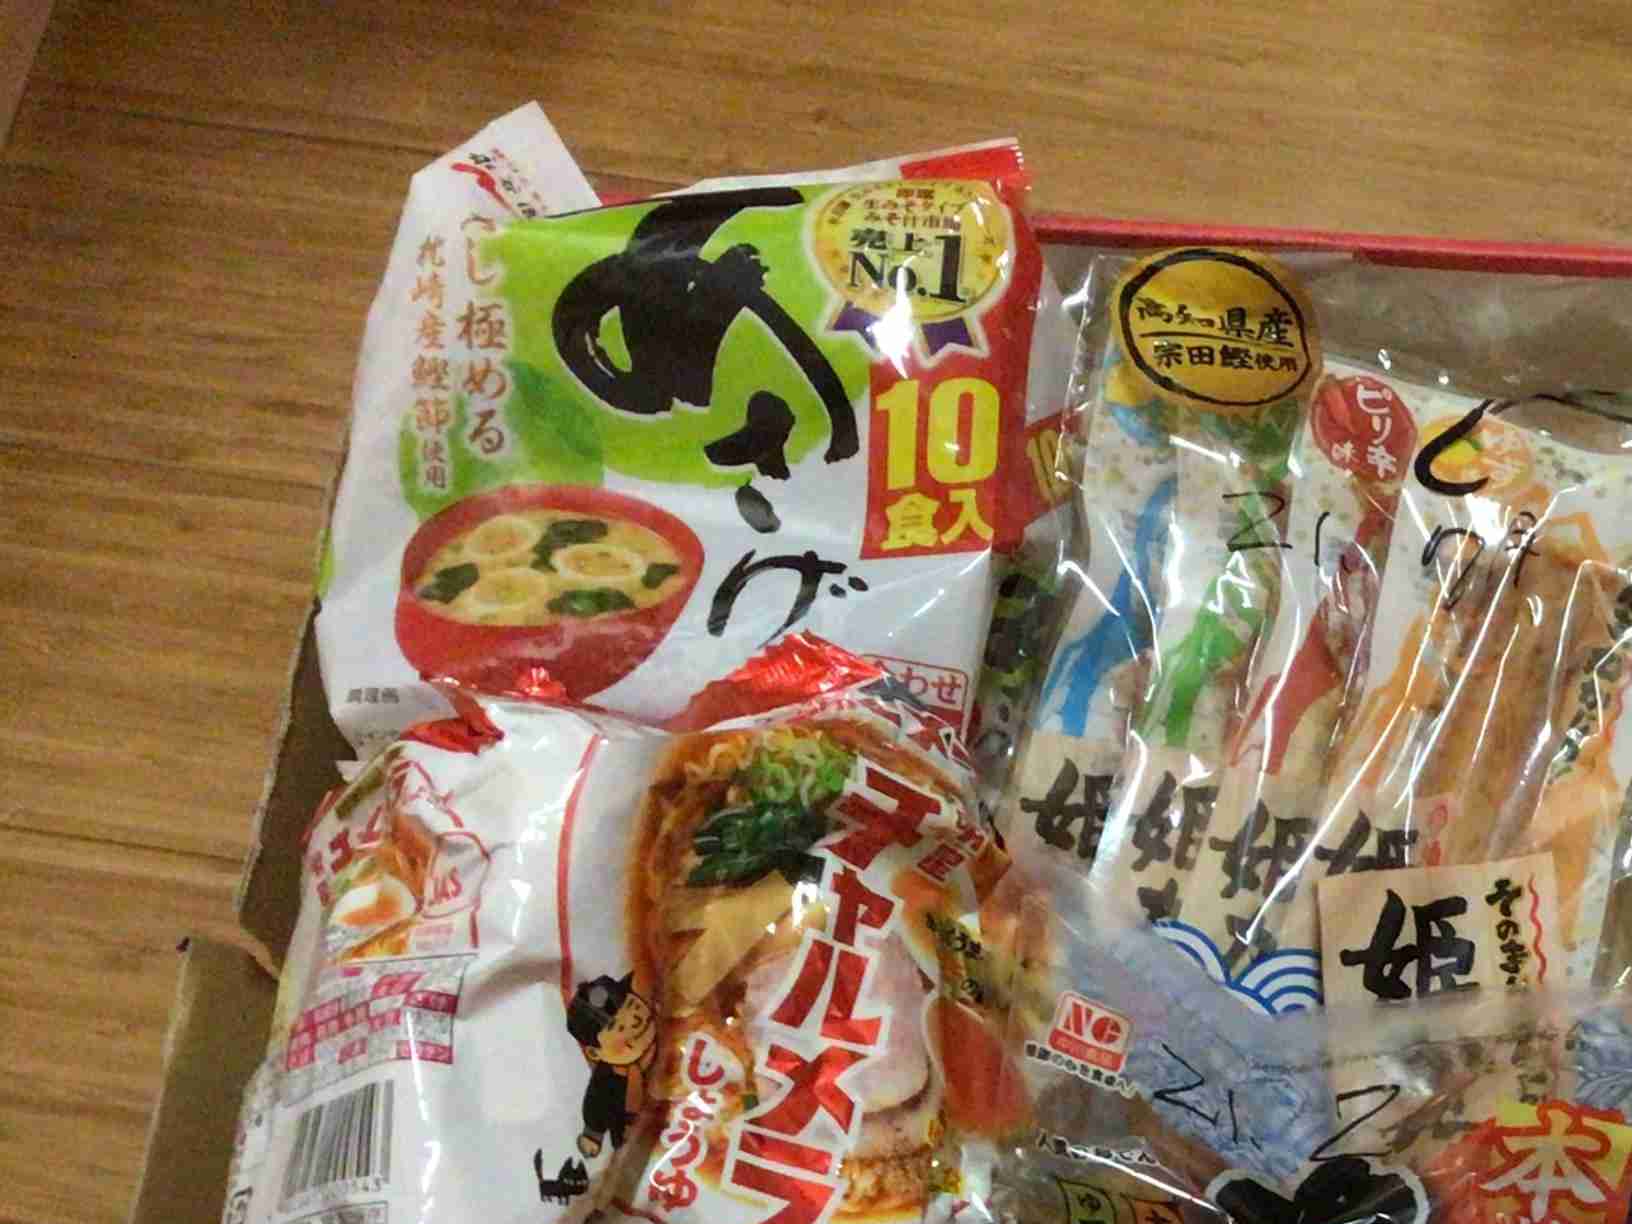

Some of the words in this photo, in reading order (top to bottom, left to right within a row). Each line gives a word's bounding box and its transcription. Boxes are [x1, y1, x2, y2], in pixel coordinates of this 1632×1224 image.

[848, 234, 968, 303] No.1
[850, 228, 930, 252] 売上
[1136, 299, 1294, 348] 高知県産
[1151, 341, 1298, 375] 宗田鰹使用
[873, 376, 1000, 490] 10
[1330, 440, 1360, 478] 味
[1354, 382, 1399, 480] ピリ辛
[880, 495, 995, 551] 食入
[1340, 887, 1481, 1000] 姫
[1485, 878, 1531, 987] そのま
[646, 1037, 725, 1211] しょうゆ
